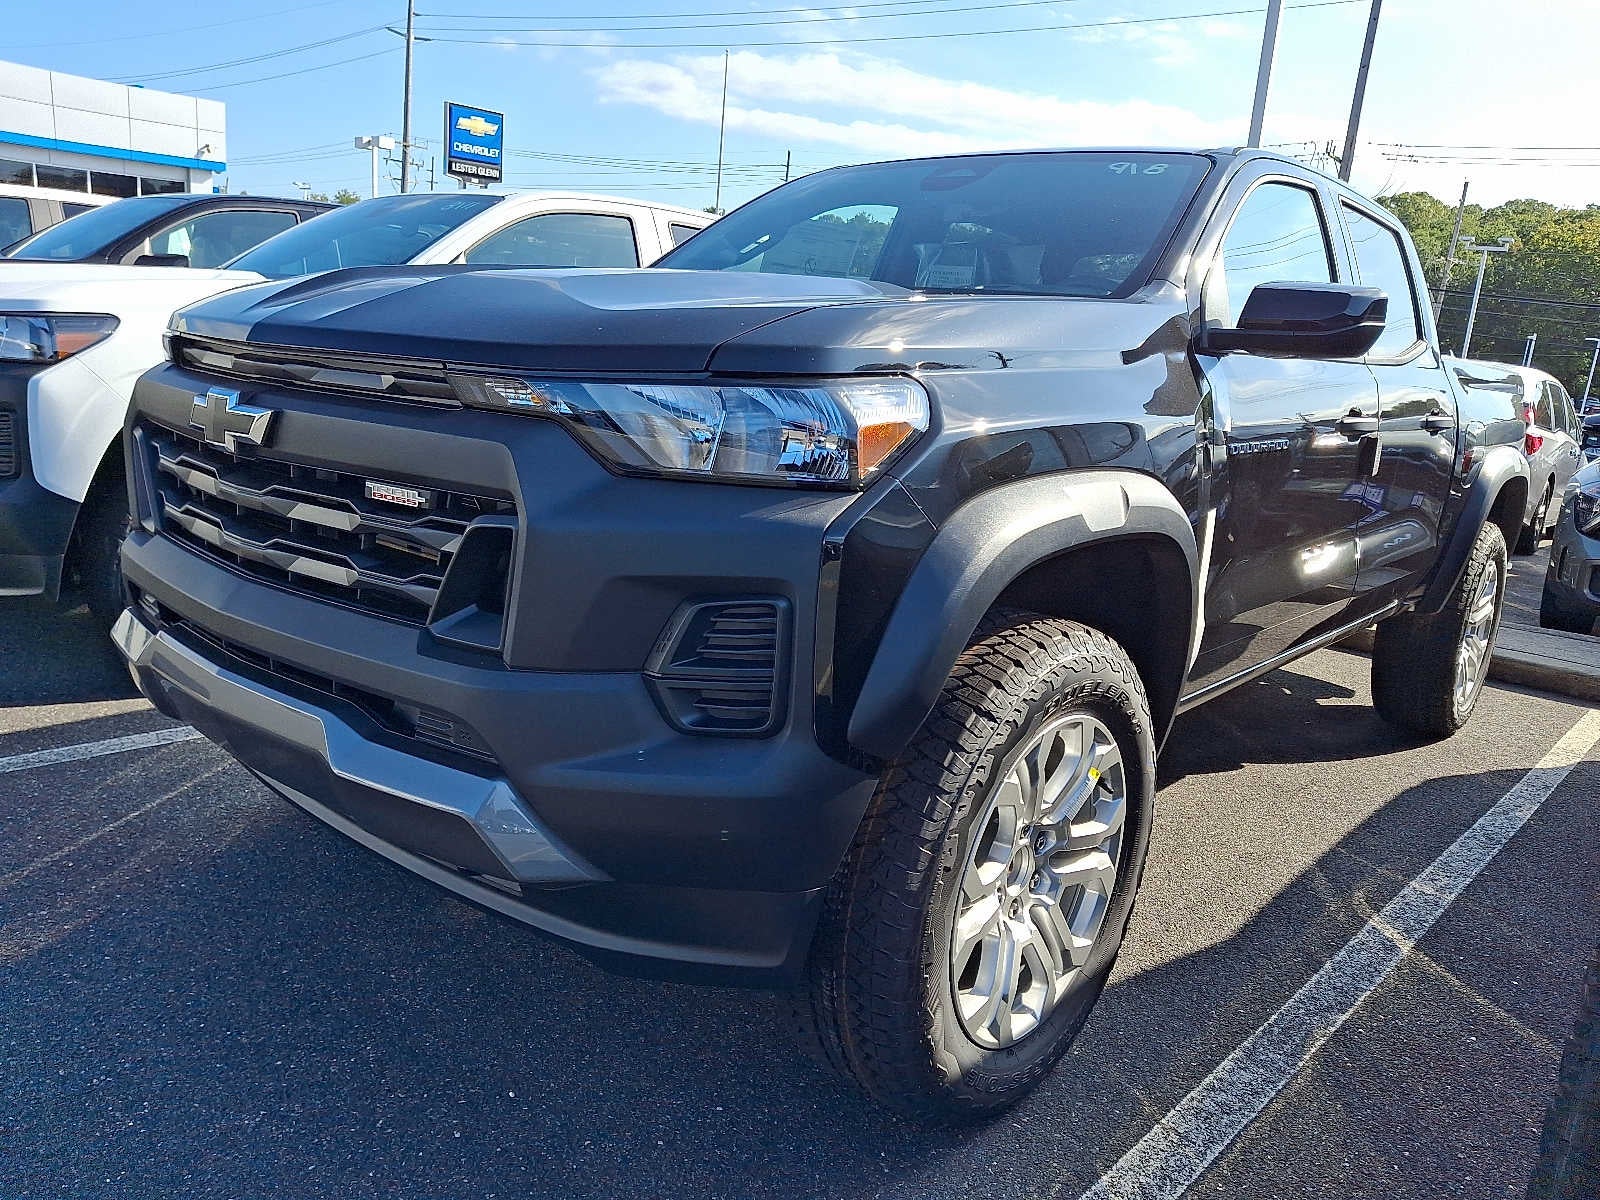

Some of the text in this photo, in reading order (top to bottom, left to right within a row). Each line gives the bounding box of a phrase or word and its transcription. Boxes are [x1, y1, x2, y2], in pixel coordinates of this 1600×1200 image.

[453, 141, 500, 158] CHEVROLET
[451, 161, 500, 179] LESTER GLENN
[372, 491, 418, 506] BOSS
